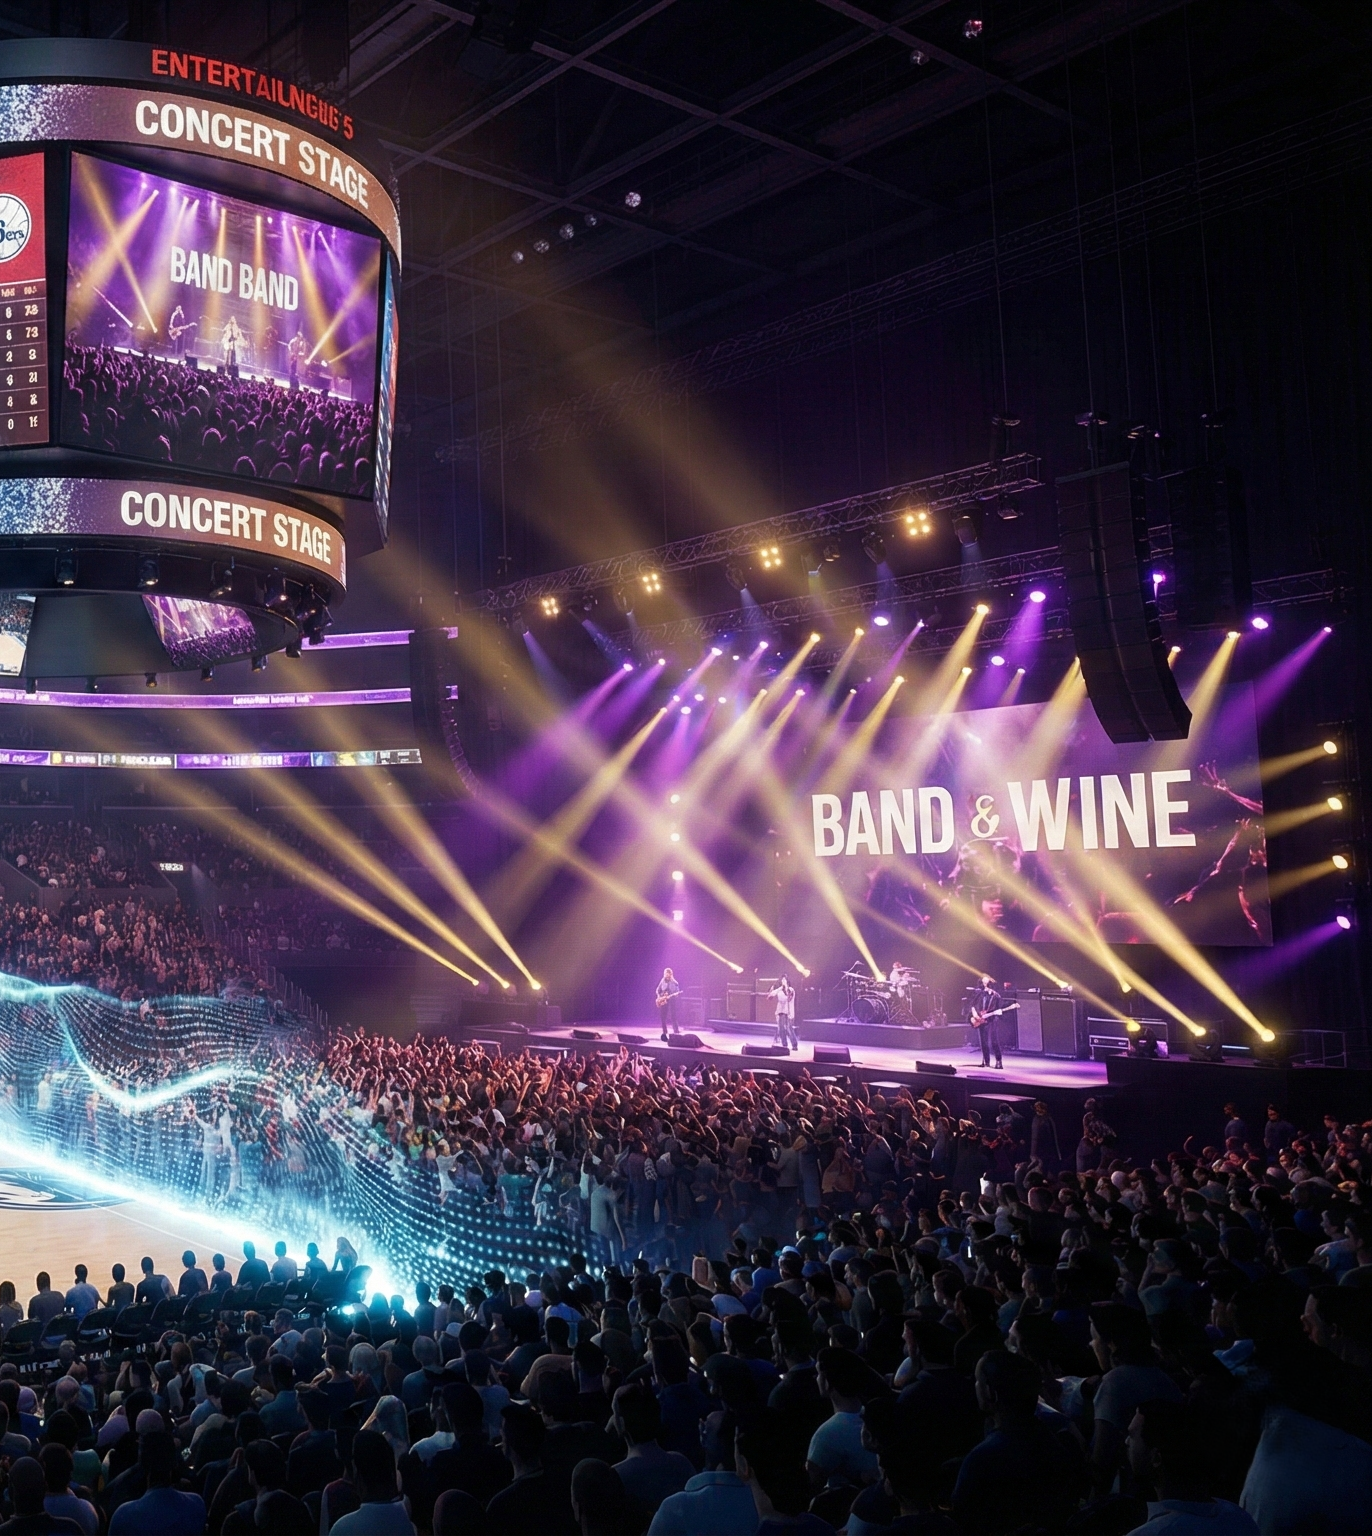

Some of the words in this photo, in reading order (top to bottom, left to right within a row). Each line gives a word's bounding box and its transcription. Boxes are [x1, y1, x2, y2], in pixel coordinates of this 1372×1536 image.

[135, 100, 290, 166] CONCERT
[298, 141, 369, 210] STAGE
[170, 246, 233, 294] BAND
[239, 264, 298, 311] BAND
[120, 491, 267, 542] CONCERT
[273, 513, 331, 564] STAGE
[811, 786, 955, 857] BAND
[970, 794, 1000, 838] &
[1007, 769, 1197, 852] WINE
